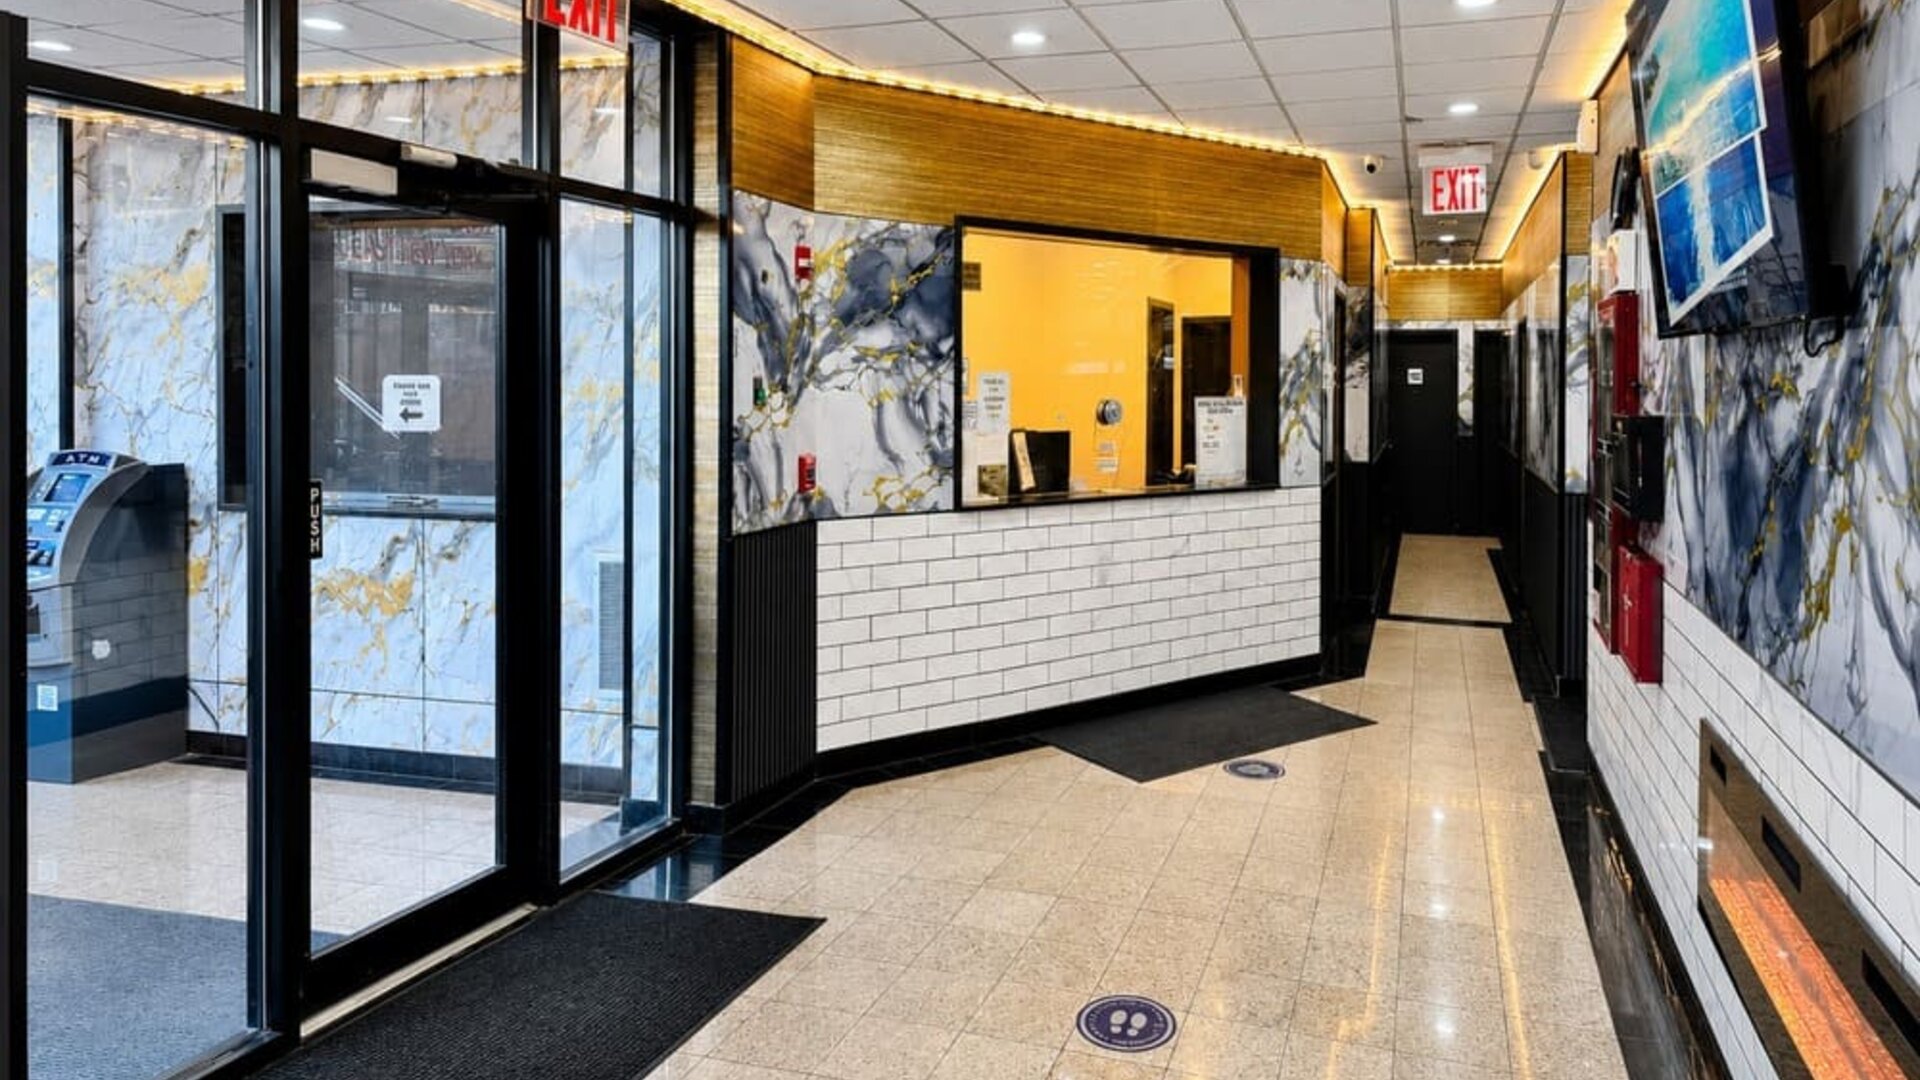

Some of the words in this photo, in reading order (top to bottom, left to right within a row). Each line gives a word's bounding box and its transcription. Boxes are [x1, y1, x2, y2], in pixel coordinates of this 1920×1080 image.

[1432, 167, 1479, 212] EXIT
[65, 454, 101, 464] ATM
[310, 487, 320, 553] PUSH
